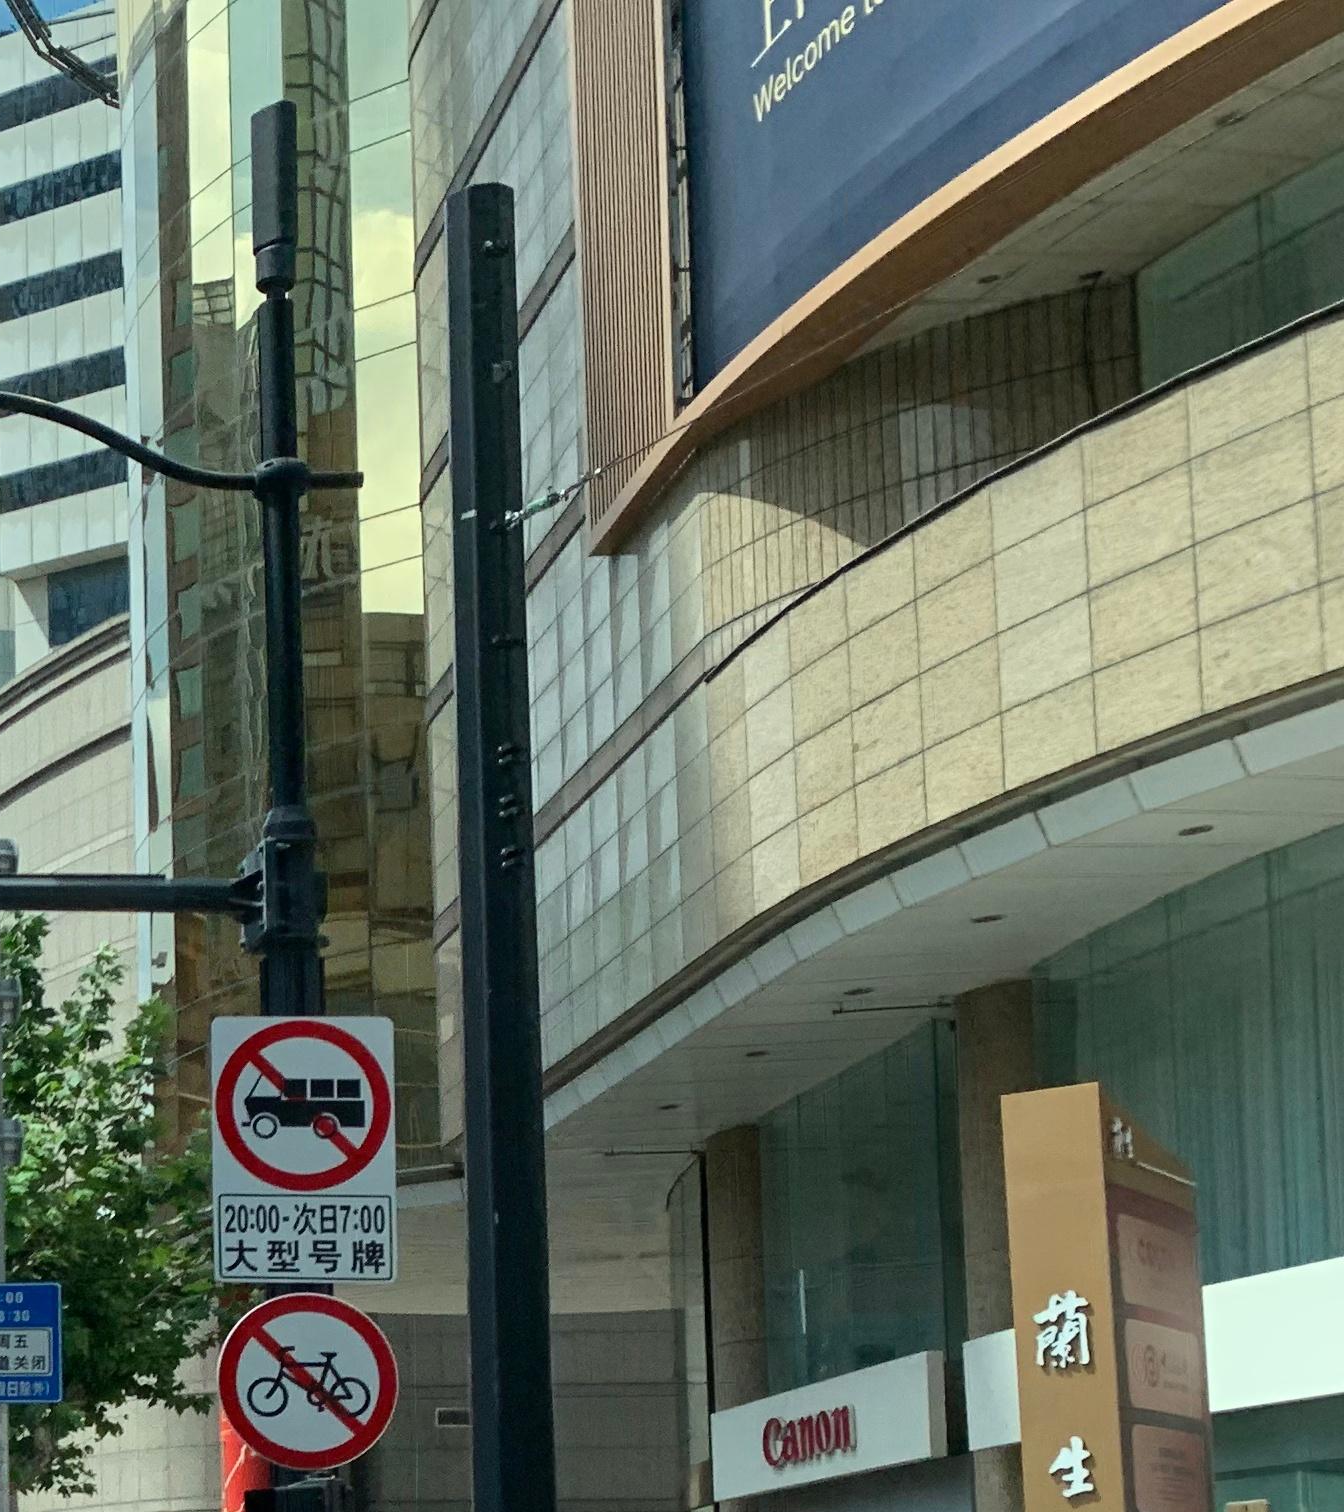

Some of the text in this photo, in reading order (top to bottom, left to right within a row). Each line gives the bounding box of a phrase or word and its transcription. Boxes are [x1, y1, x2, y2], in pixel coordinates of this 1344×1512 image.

[753, 5, 855, 122] Welcome
[225, 1239, 386, 1274] 大型号牌
[762, 1405, 857, 1467] Canon
